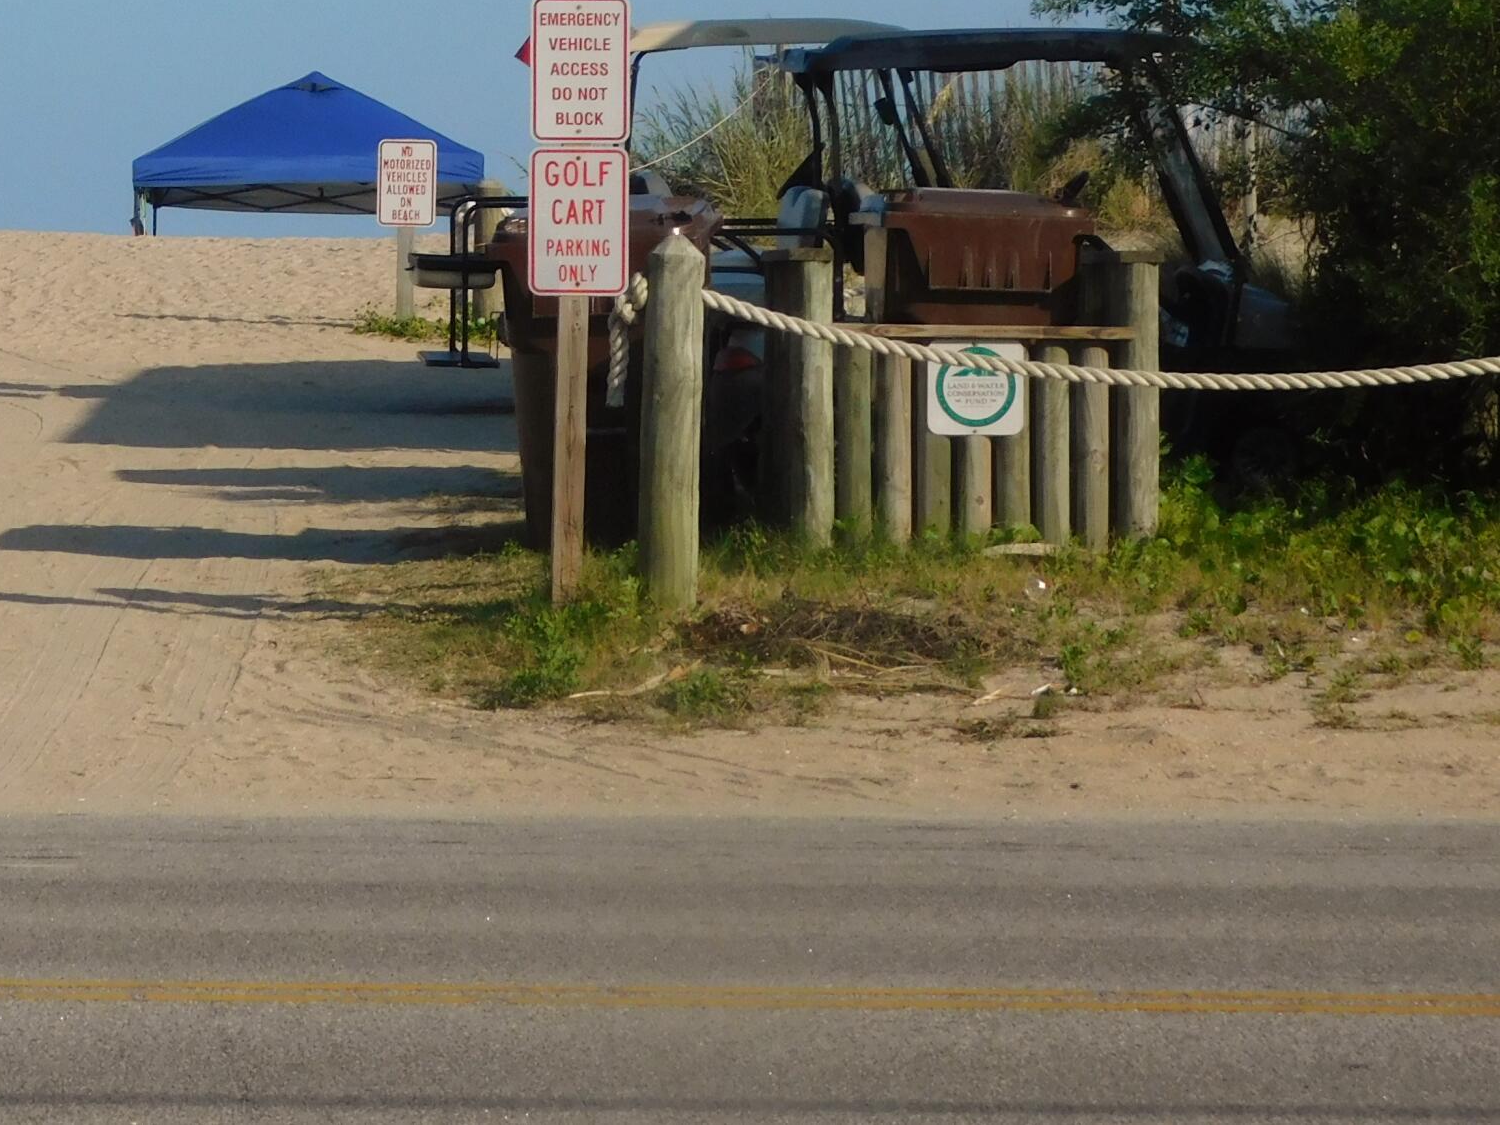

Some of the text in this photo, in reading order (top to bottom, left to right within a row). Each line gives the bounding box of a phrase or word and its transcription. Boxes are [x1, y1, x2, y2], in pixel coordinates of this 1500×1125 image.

[539, 13, 620, 26] EMERGENCY
[549, 37, 611, 51] VEHICLE
[550, 62, 609, 76] ACCESS
[552, 87, 607, 101] DO NOT
[556, 112, 603, 125] BLOCK
[402, 147, 412, 156] NO
[383, 159, 431, 170] MOTORIZED
[387, 172, 427, 182] VEHICLES
[545, 161, 612, 186] GOLF
[387, 185, 425, 195] ALLOWED
[401, 198, 412, 207] ON
[392, 210, 420, 220] BEACH
[551, 199, 605, 224] CART
[546, 240, 610, 257] PARKING
[559, 264, 597, 282] ONLY
